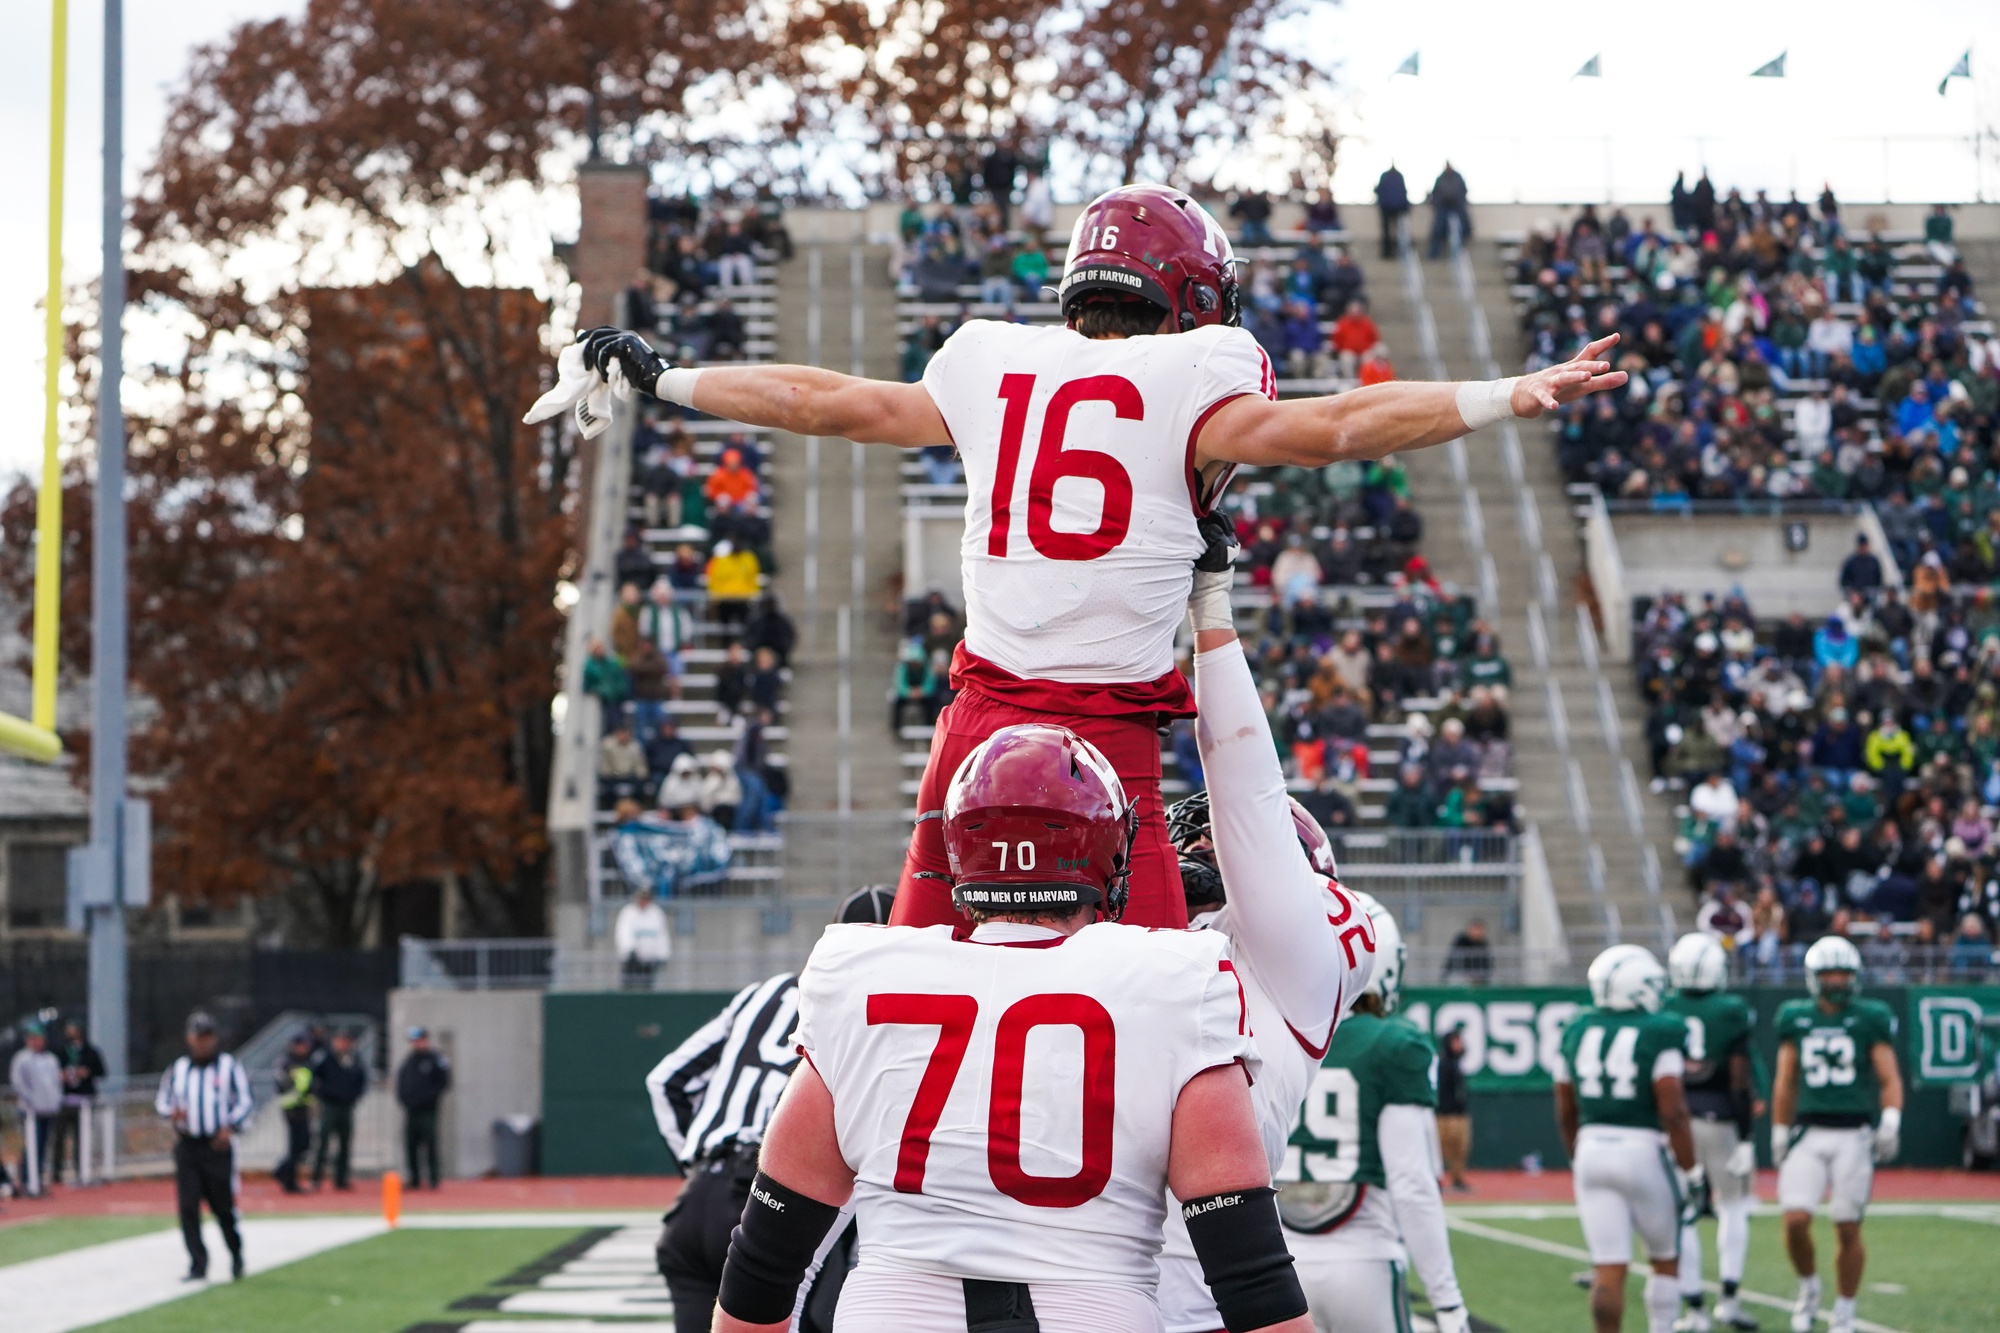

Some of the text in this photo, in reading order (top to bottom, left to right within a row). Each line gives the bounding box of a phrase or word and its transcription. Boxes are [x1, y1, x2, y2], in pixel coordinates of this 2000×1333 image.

[1089, 226, 1119, 250] 16
[1072, 270, 1142, 288] MEN OF HARVARD
[987, 372, 1144, 561] 16
[992, 841, 1035, 871] 70
[1056, 857, 1079, 872] Ivy
[962, 890, 1078, 903] 10,000 MEN OF HARVARD
[1575, 1025, 1640, 1098] 44
[1801, 1036, 1856, 1088] 53
[865, 992, 1116, 1209] 70
[751, 1181, 785, 1213] ueller.
